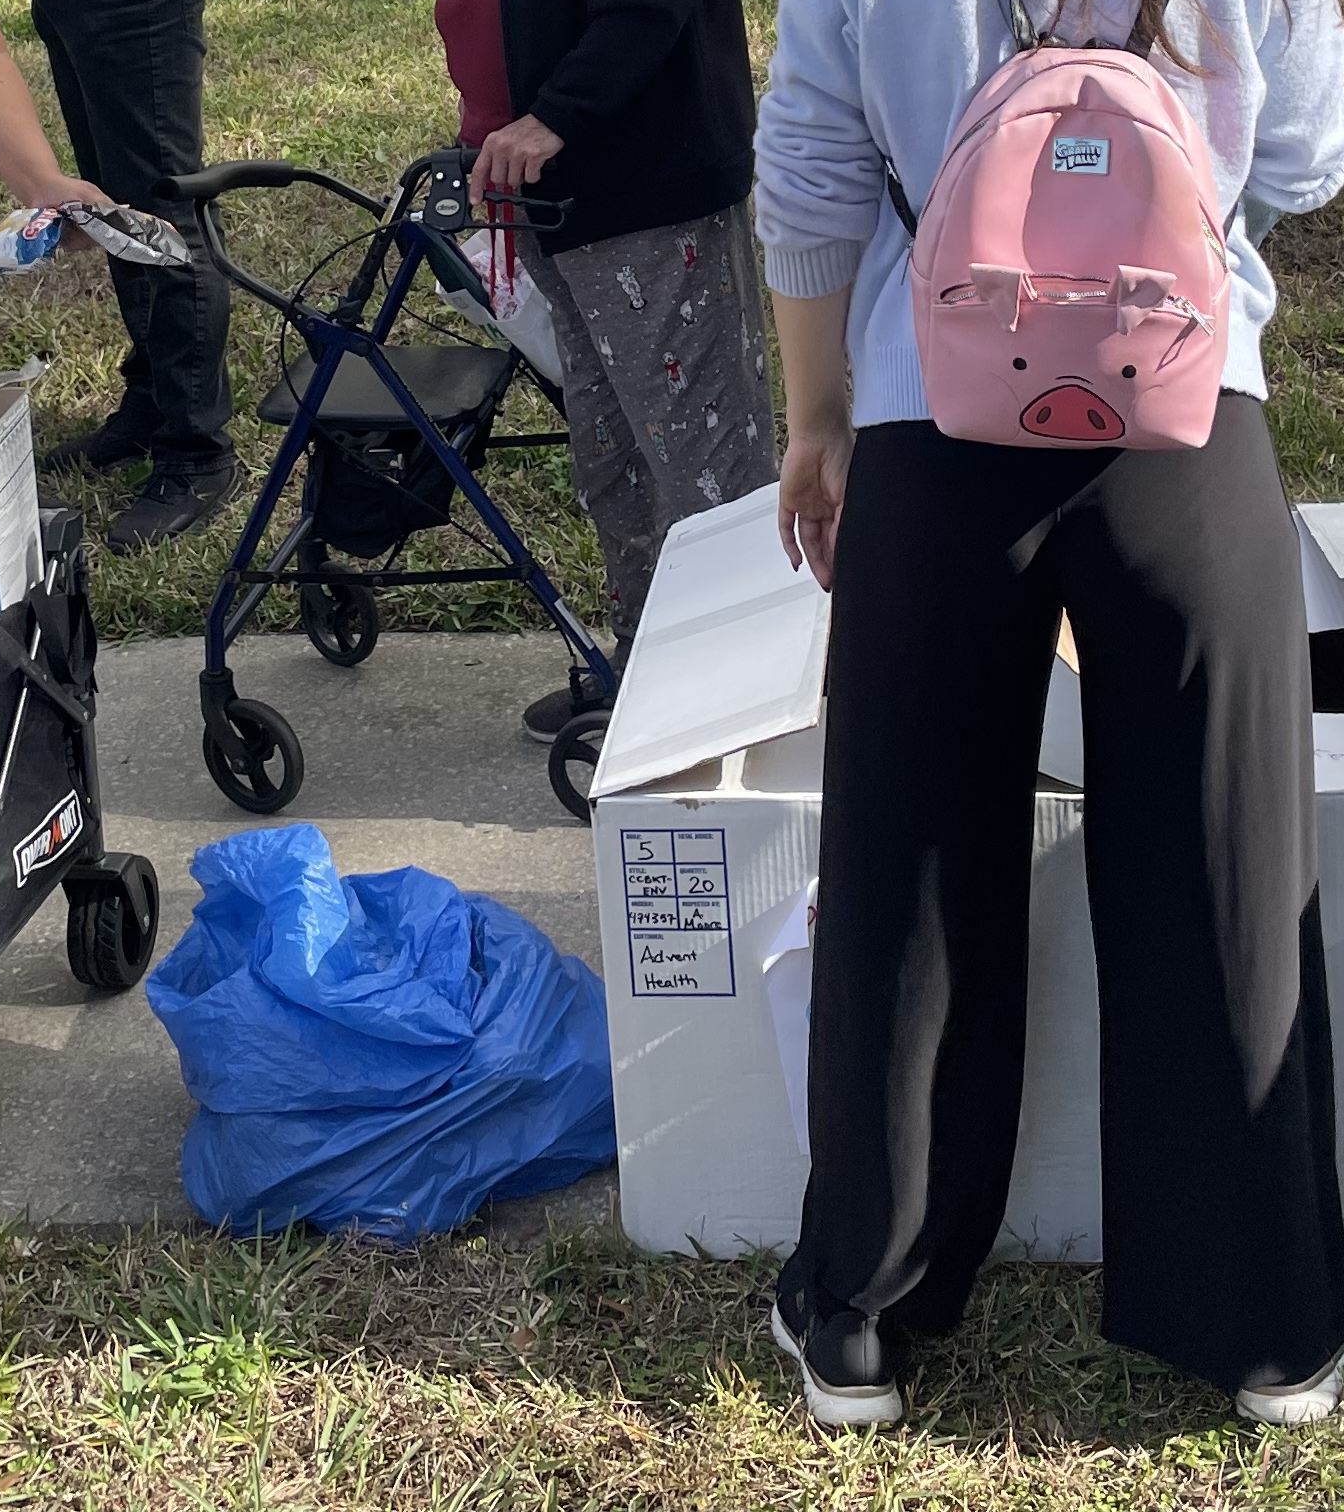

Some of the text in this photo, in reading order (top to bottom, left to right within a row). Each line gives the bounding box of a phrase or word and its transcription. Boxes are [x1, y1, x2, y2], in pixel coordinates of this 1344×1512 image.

[637, 841, 654, 860] 5
[689, 876, 714, 894] 20
[640, 945, 698, 965] Advent
[644, 973, 698, 991] Health
